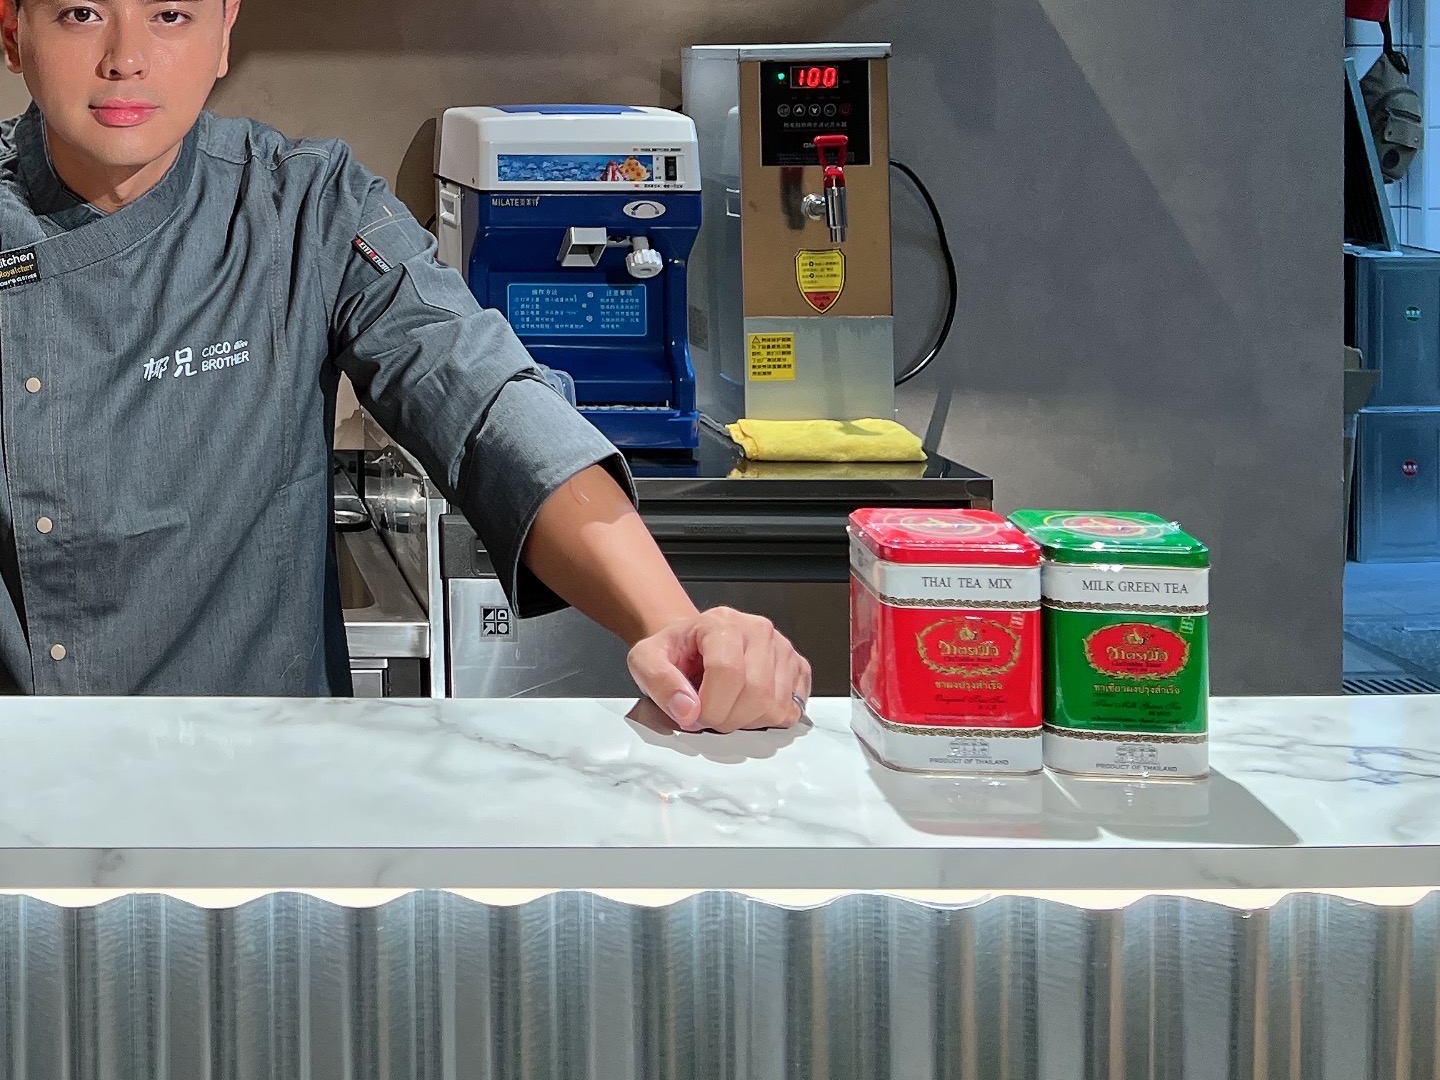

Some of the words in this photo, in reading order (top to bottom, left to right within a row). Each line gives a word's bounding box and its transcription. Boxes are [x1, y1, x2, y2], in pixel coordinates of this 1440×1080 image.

[798, 67, 837, 88] 100
[492, 198, 519, 207] MILATE
[201, 341, 231, 358] COCO
[143, 347, 198, 381] 椰兄
[201, 351, 250, 372] BROTHER
[922, 576, 952, 588] THAI
[959, 577, 982, 588] TEA
[988, 578, 1012, 589] MIX
[1082, 580, 1114, 592] MILK
[1118, 581, 1161, 593] GREEN
[1164, 583, 1189, 595] TEA
